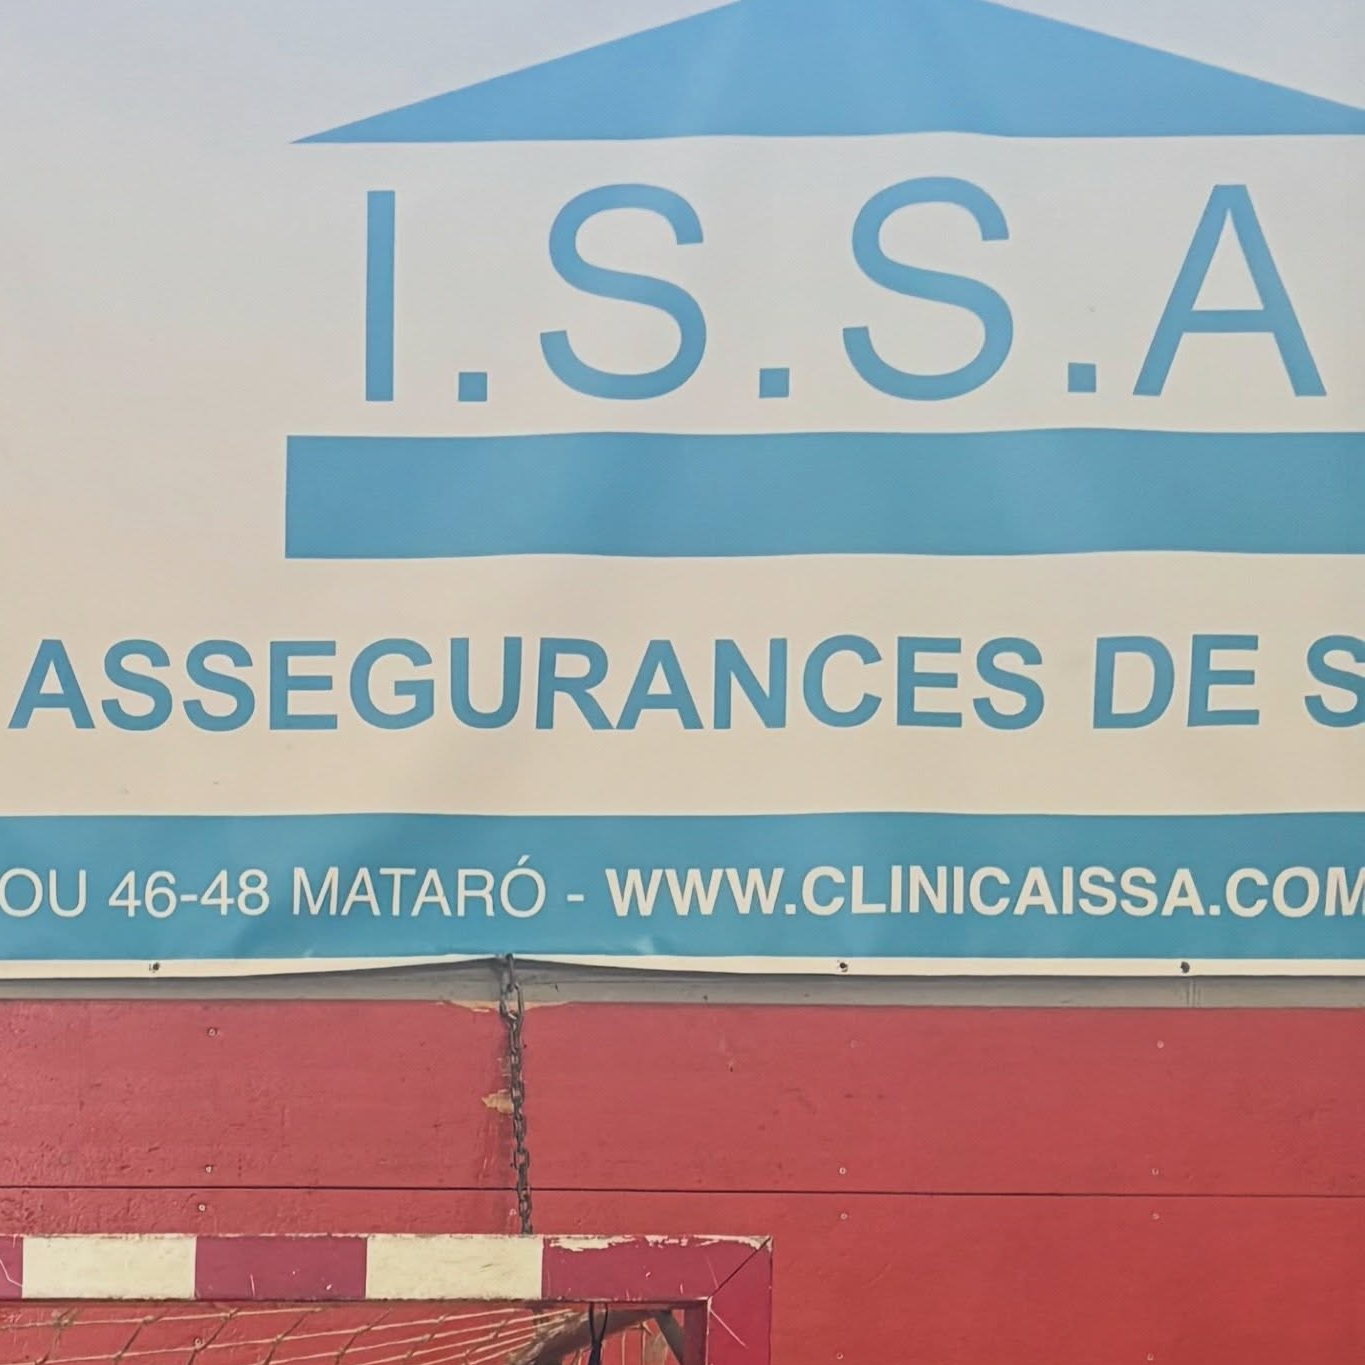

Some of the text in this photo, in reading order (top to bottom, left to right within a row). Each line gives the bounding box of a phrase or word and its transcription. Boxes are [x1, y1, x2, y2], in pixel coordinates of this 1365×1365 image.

[8, 635, 1045, 731] ASSEGURANCES
[1093, 634, 1260, 729] DE
[109, 868, 270, 919] 46-48
[293, 855, 546, 918] MATARÓ
[605, 865, 1365, 918] WWW.CLINICAISSA.COM
